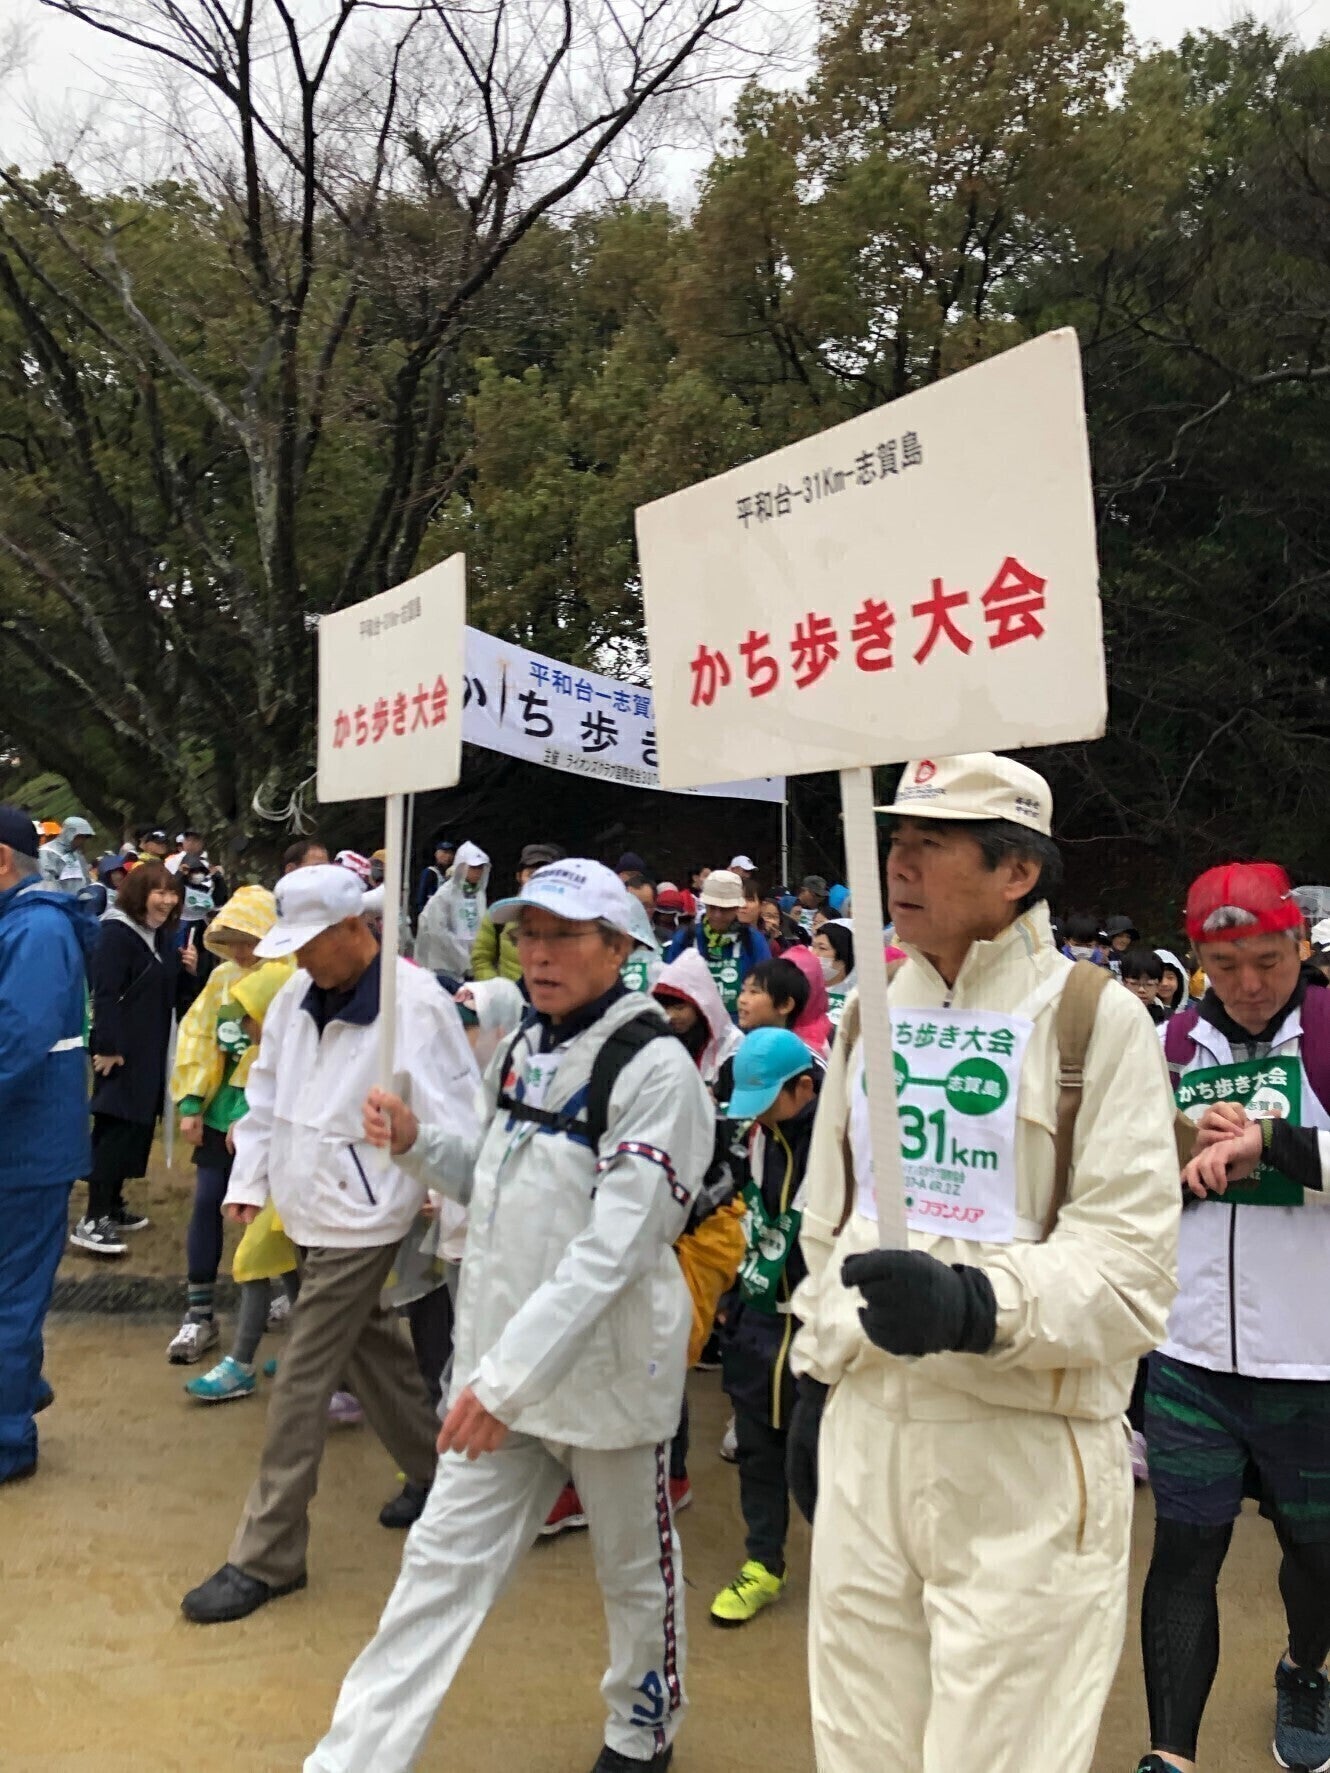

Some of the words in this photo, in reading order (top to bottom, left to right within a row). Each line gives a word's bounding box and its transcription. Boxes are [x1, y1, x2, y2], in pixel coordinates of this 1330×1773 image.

[689, 556, 1049, 708] かち歩き大会
[332, 674, 449, 750] かち歩き大会
[947, 1075, 1002, 1099] 志賀島
[1178, 1067, 1288, 1103] かち歩き大会
